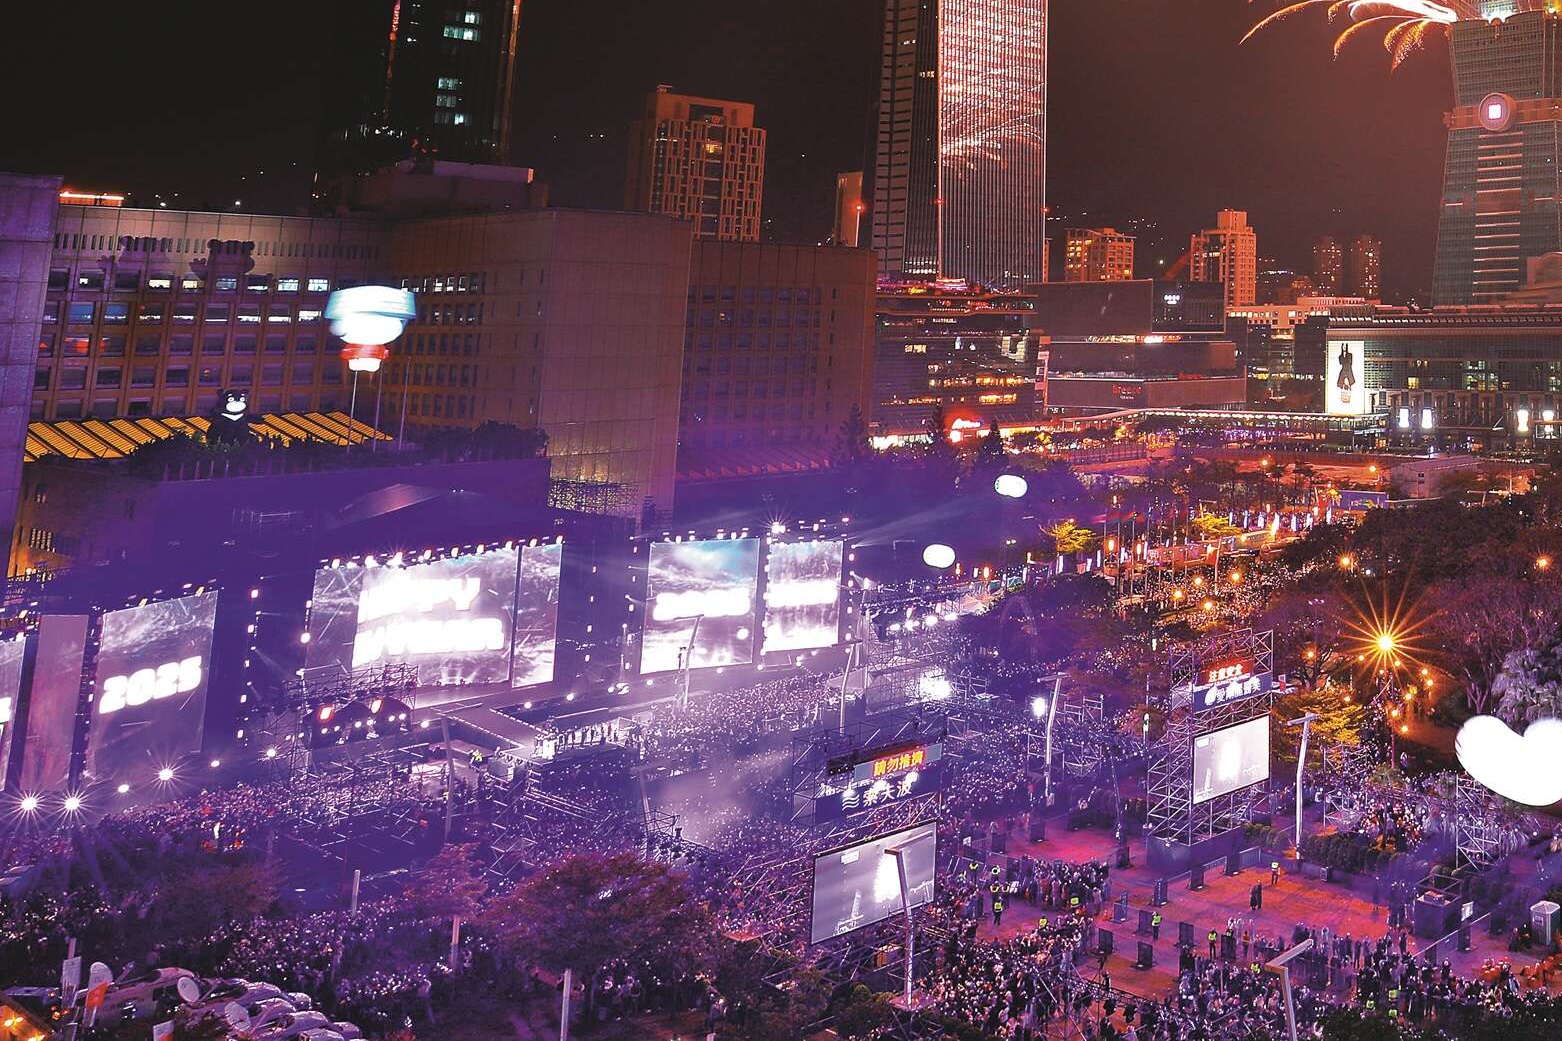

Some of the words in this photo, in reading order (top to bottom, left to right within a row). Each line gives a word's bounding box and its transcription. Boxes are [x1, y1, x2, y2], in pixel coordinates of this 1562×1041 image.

[98, 655, 203, 714] 2025
[873, 750, 924, 776] 請勿推擠
